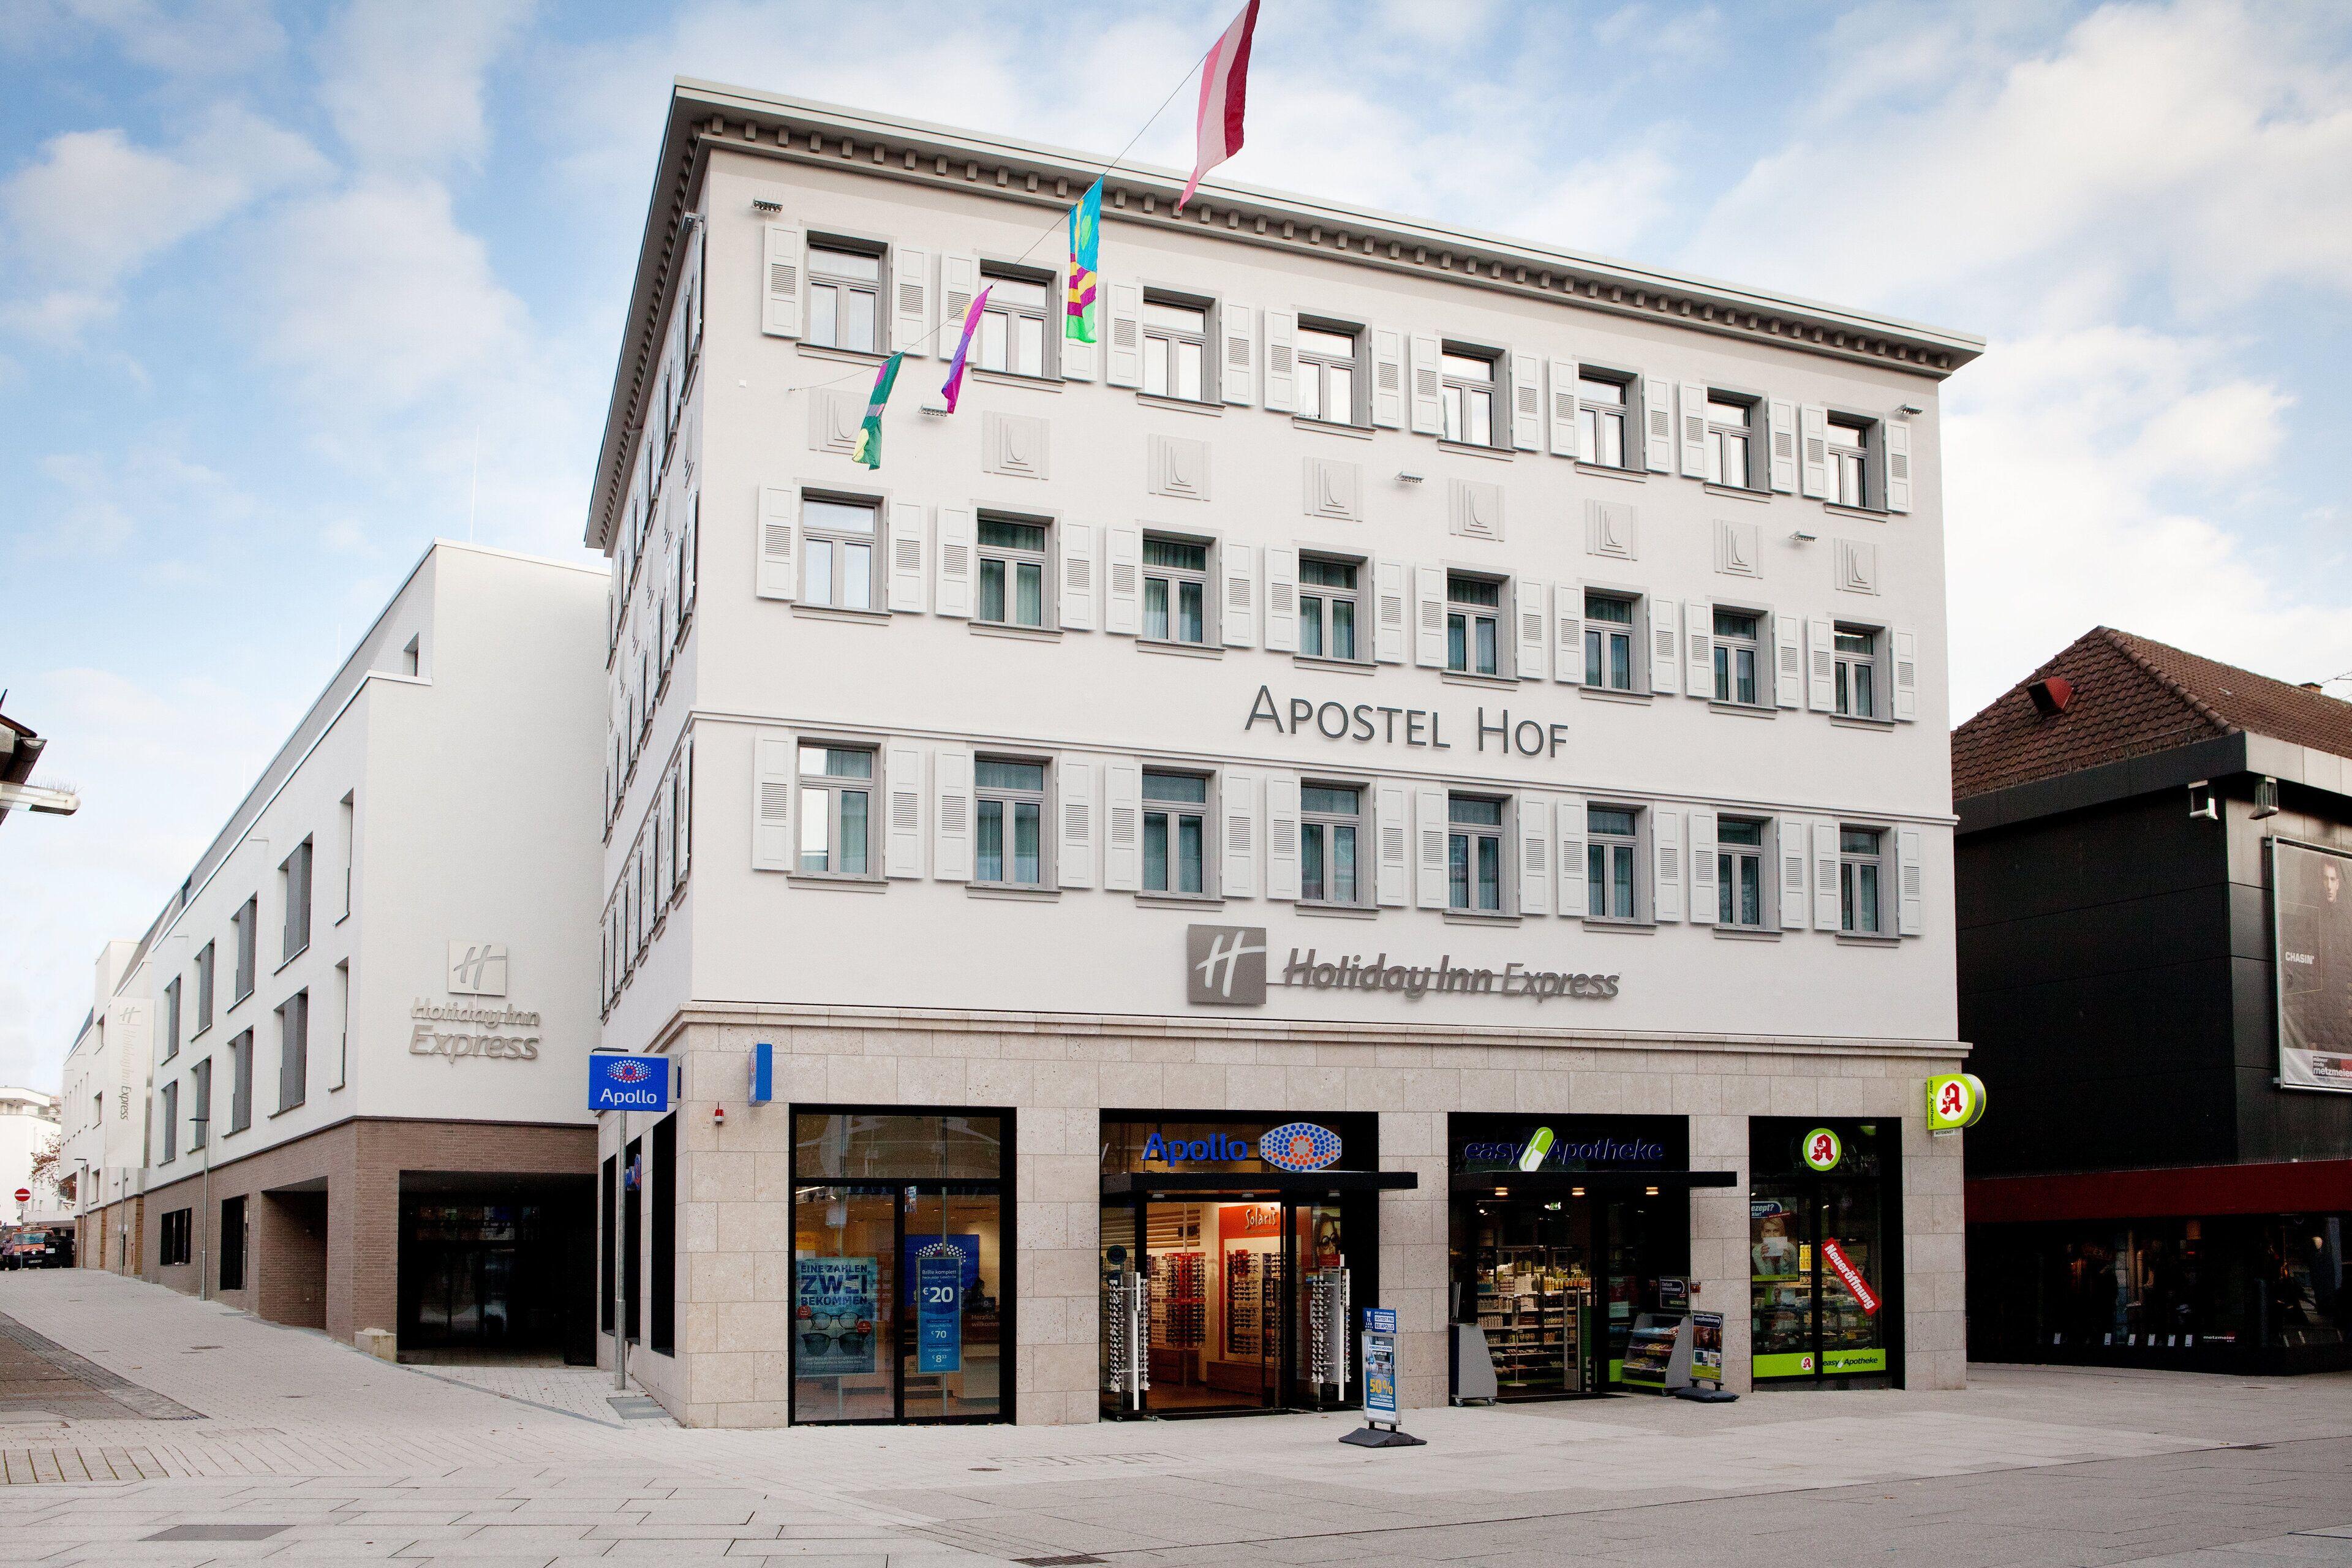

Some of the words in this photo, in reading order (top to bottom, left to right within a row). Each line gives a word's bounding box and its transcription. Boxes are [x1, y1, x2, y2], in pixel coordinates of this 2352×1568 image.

[1501, 963, 1621, 1003] Express
[409, 1024, 540, 1065] Express
[118, 1085, 132, 1120] Express
[600, 1088, 657, 1106] Apollo
[1142, 1133, 1248, 1167] Apollo
[1464, 1142, 1524, 1165] easy
[1545, 1138, 1664, 1165] Apotheke
[1244, 1207, 1276, 1229] Solaris
[801, 1265, 824, 1273] EINE
[1825, 1243, 1875, 1310] Neueröffnung
[800, 1275, 868, 1295] ZWEI
[1844, 1357, 1879, 1365] Apotheke
